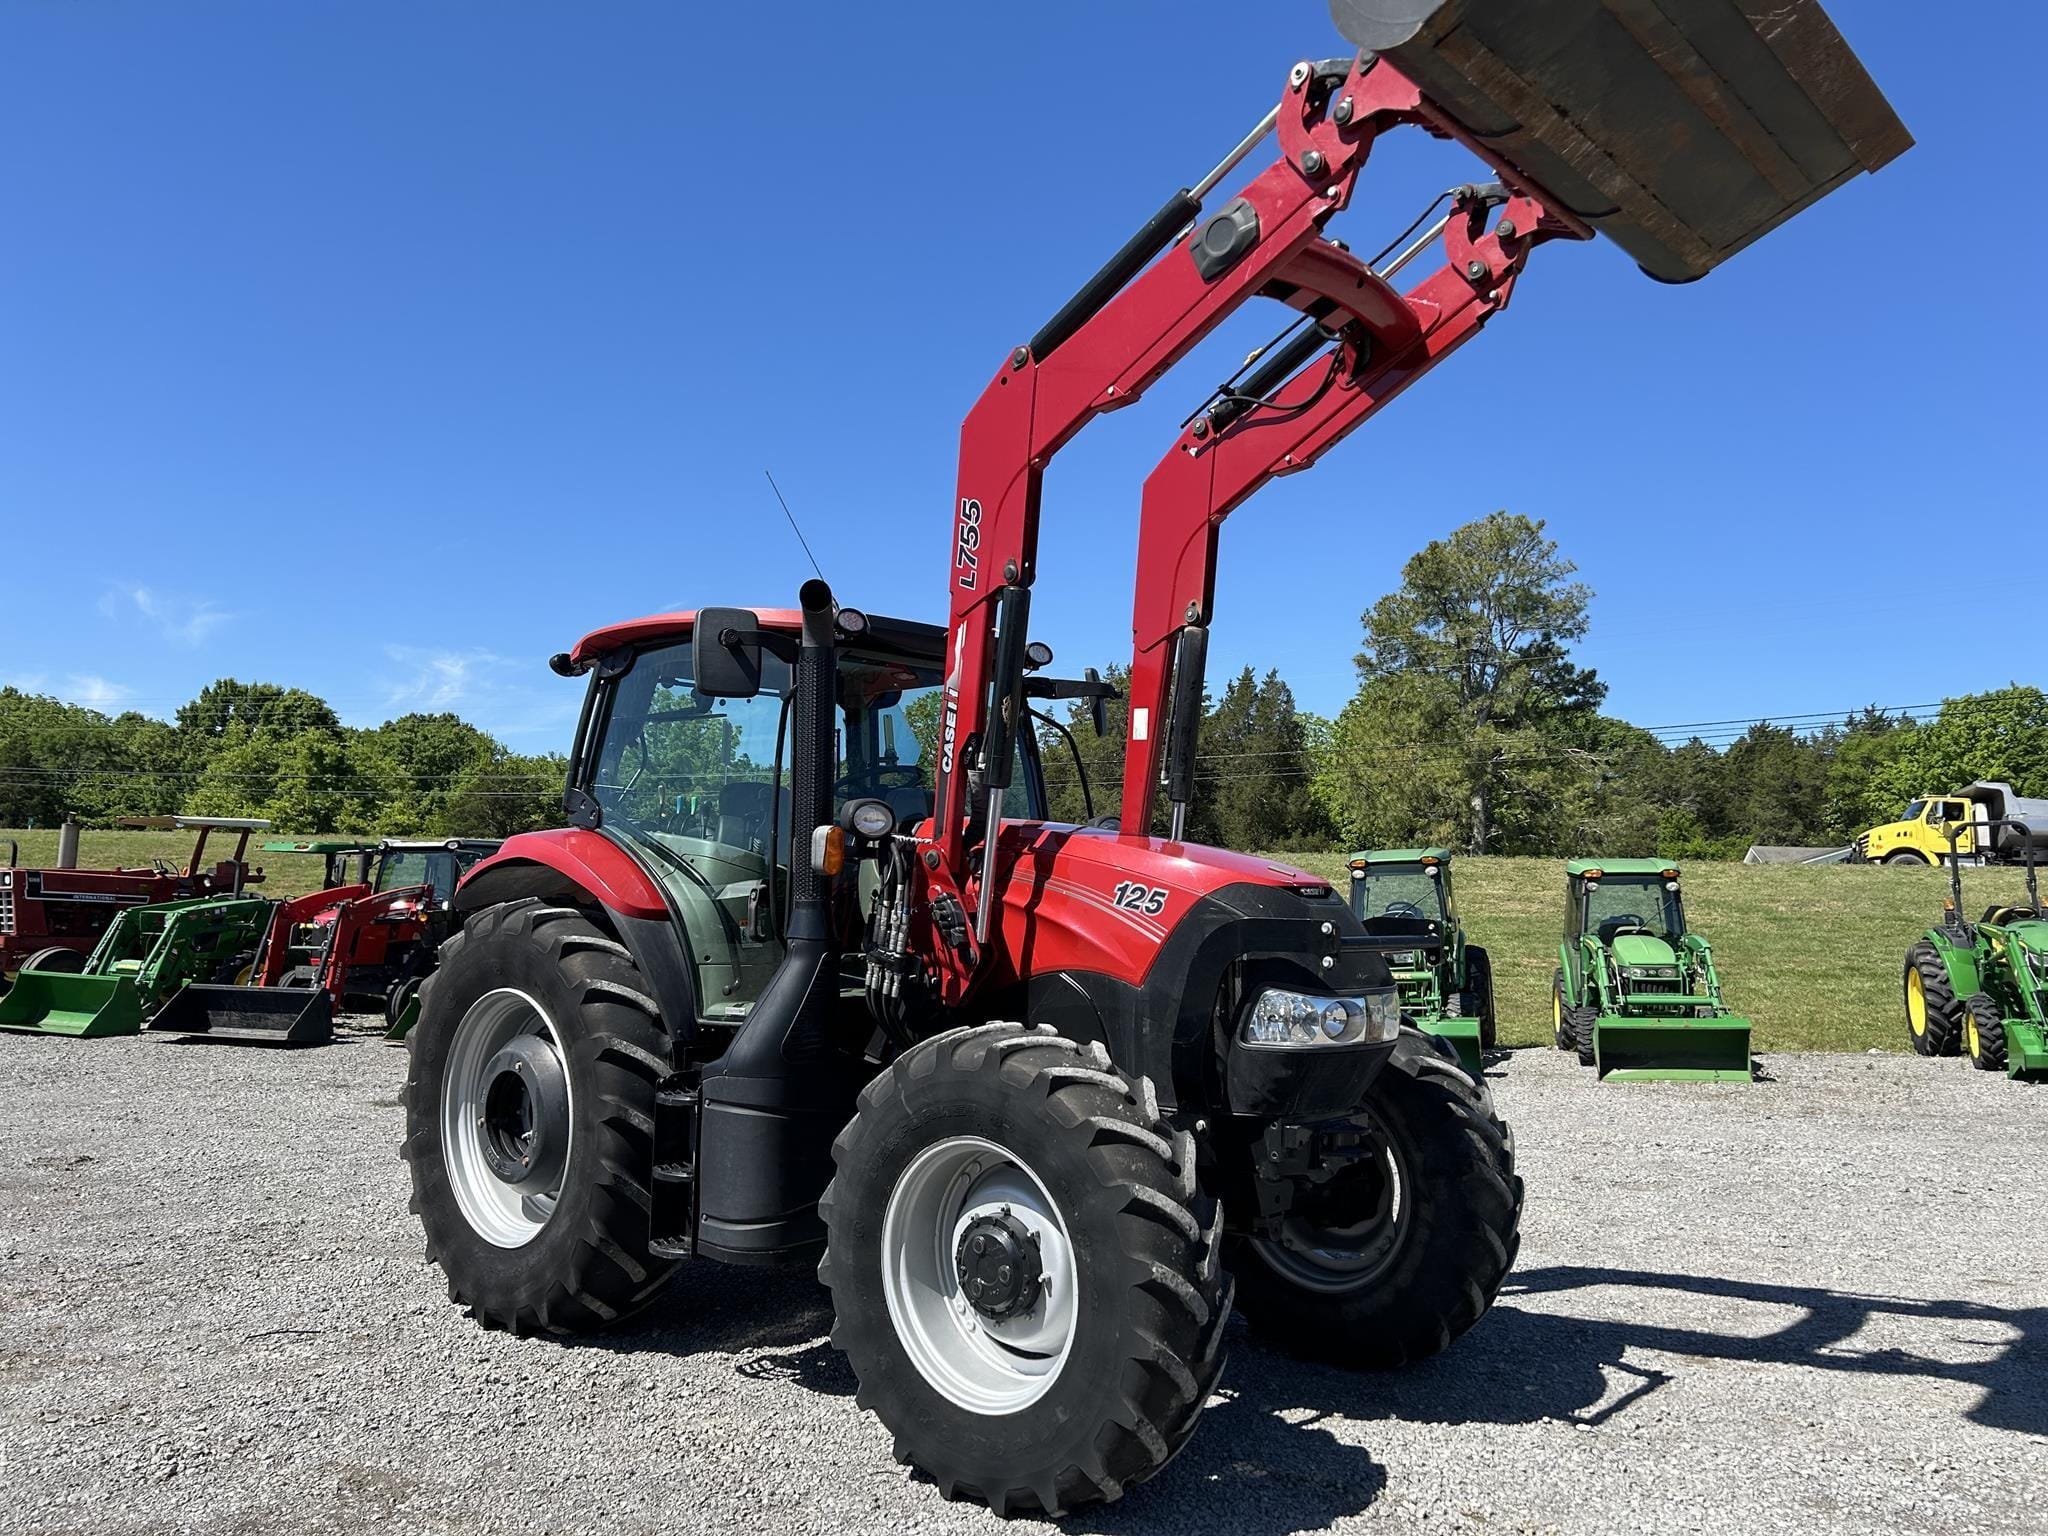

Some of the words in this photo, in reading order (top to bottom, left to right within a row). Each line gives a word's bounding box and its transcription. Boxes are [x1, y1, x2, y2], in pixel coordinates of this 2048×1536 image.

[956, 498, 982, 590] L755
[942, 710, 957, 774] CASE
[1112, 880, 1169, 917] 125
